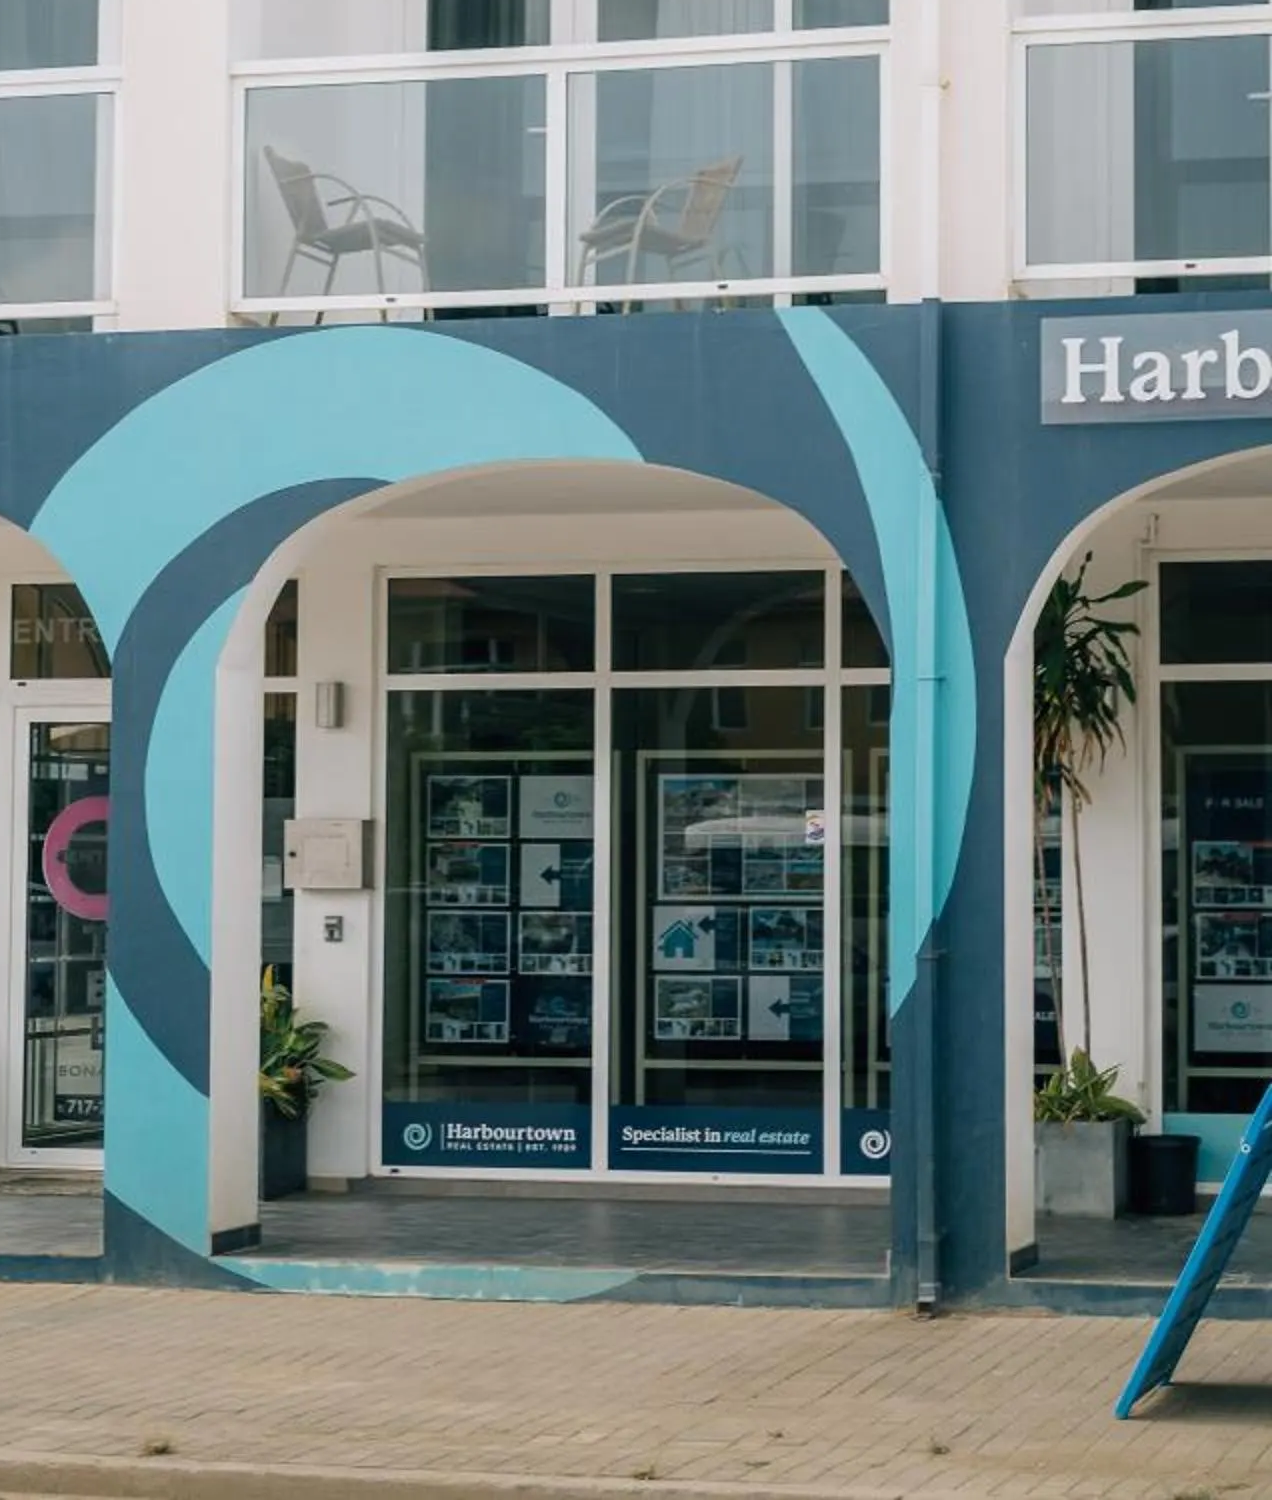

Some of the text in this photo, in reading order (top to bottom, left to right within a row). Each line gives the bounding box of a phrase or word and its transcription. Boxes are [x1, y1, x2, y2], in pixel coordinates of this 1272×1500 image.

[1060, 329, 1272, 404] Harb
[446, 1123, 577, 1142] Harbourtown
[621, 1125, 811, 1146] Specialist in real estate
[446, 1141, 473, 1152] REAL
[476, 1141, 514, 1153] ESTATE
